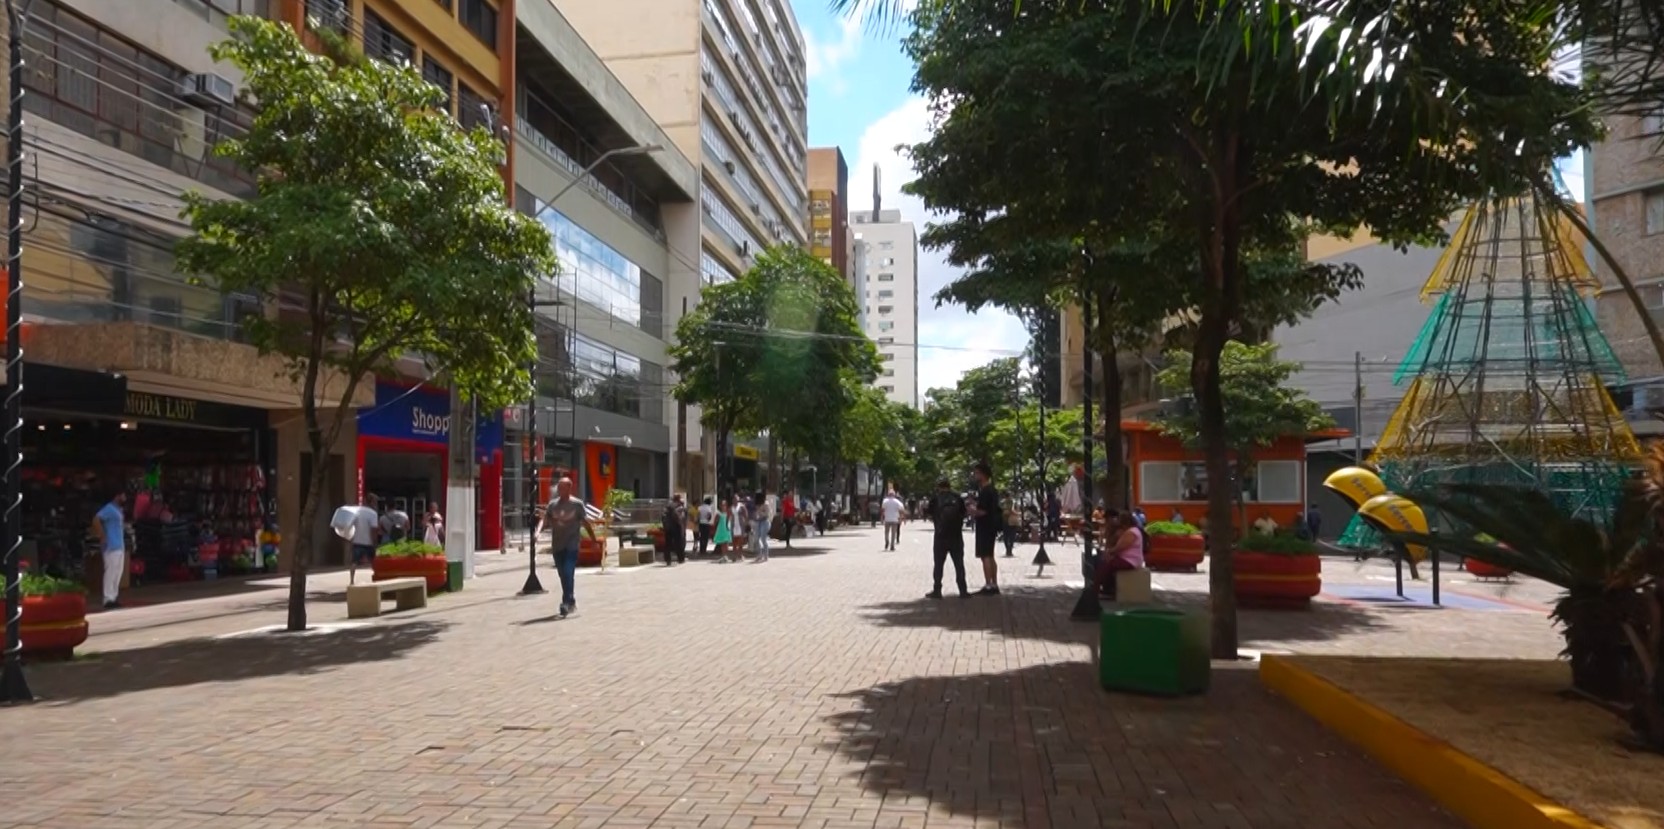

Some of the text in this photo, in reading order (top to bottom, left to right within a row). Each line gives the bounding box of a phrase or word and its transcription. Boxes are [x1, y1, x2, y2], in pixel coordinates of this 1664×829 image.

[124, 393, 197, 420] MODA LADY
[412, 406, 450, 436] Shopp
